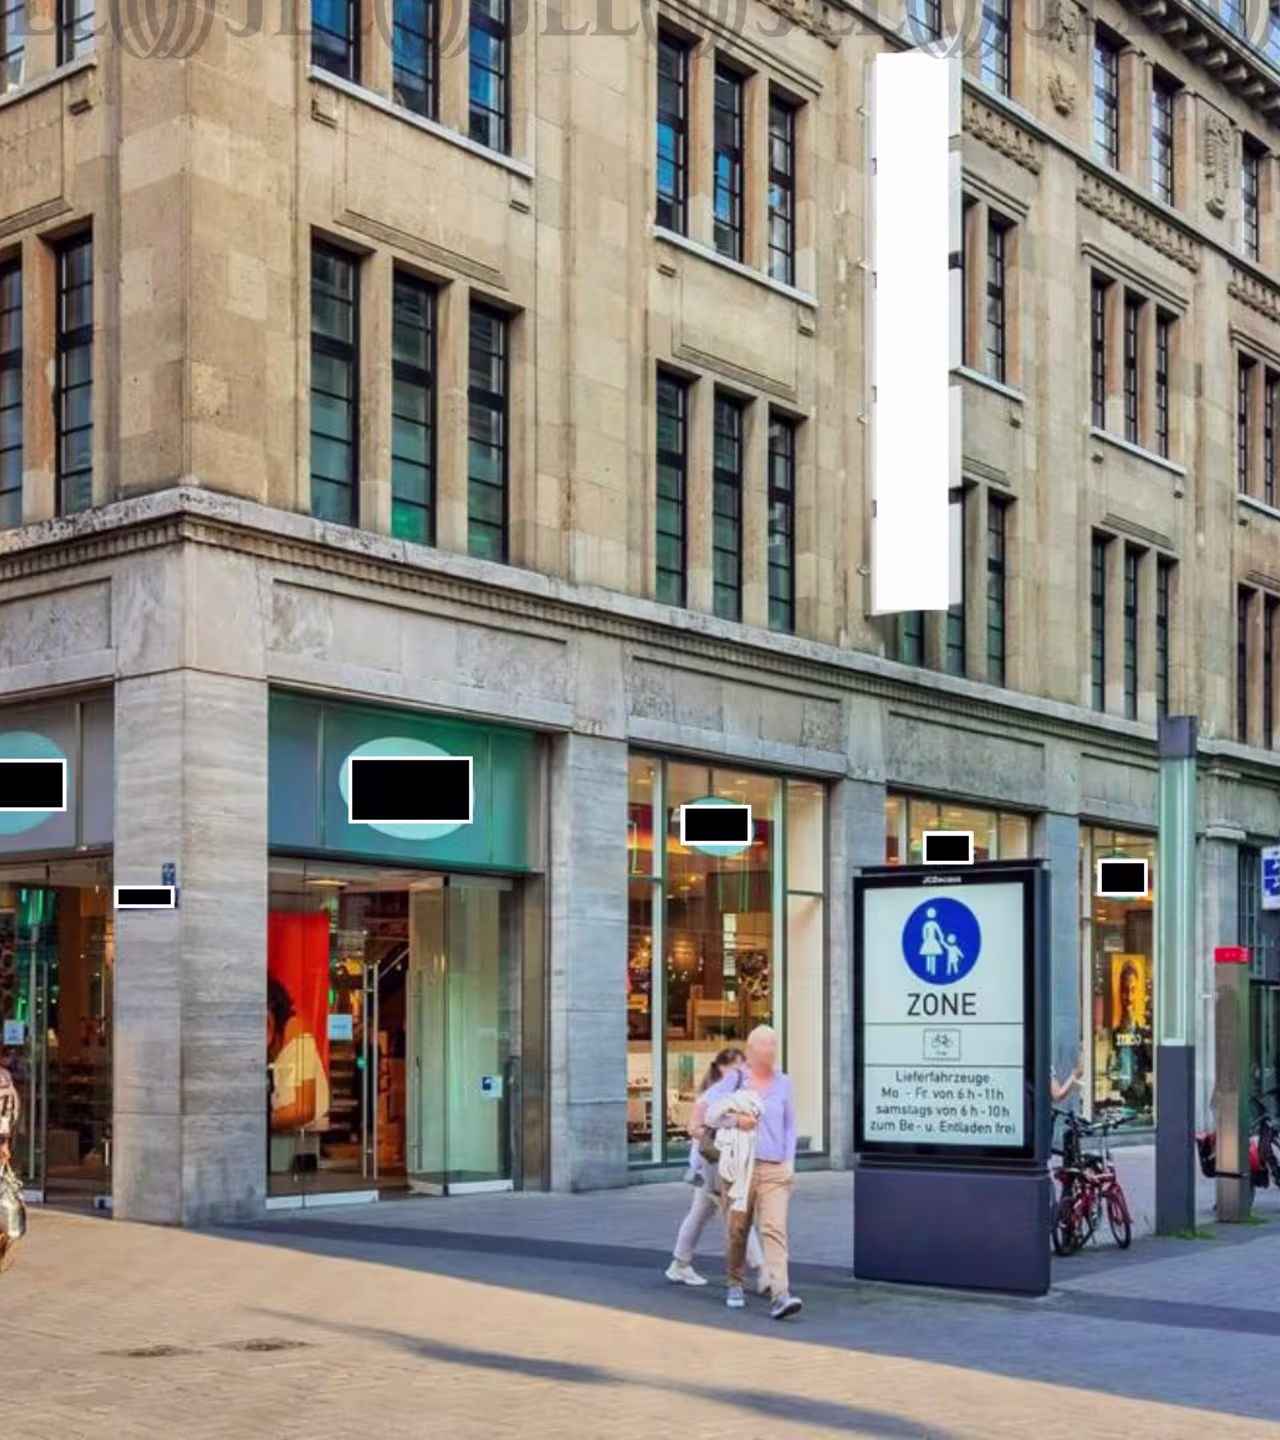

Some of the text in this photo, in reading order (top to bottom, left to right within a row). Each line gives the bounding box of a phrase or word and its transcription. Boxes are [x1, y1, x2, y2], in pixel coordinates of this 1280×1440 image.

[907, 993, 977, 1016] ZONE
[896, 1070, 990, 1086] Lieferfahrzeuge
[933, 1090, 954, 1099] von
[876, 1105, 933, 1118] samstags
[936, 1107, 957, 1116] von
[870, 1121, 895, 1131] zum
[939, 1120, 992, 1134] Entladen
[995, 1121, 1016, 1135] frei
